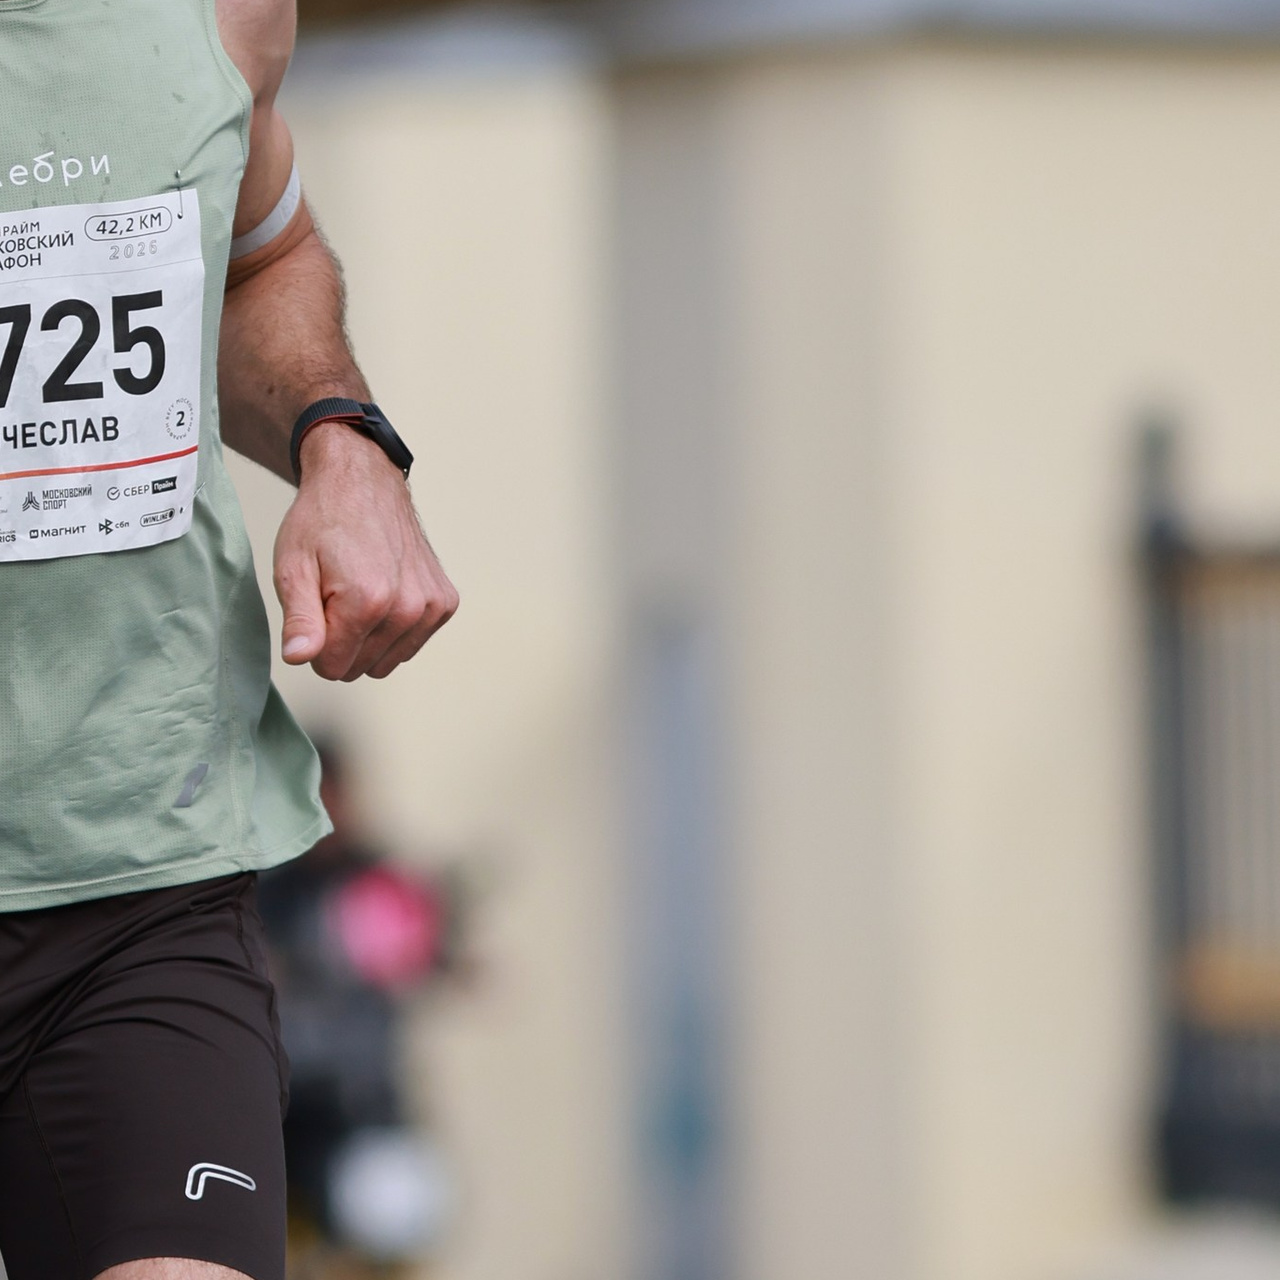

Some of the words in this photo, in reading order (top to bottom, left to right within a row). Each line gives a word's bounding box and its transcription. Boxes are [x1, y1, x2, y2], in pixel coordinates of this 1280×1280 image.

[96, 218, 137, 237] 42,2
[109, 240, 158, 260] 2026
[176, 410, 185, 427] 2
[42, 484, 93, 500] МОСКОВСКИЙ
[123, 484, 150, 497] СБЕР
[42, 499, 68, 511] СПОРТ
[115, 521, 130, 529] сбп
[142, 513, 169, 525] WINLINE
[40, 525, 87, 538] магнит
